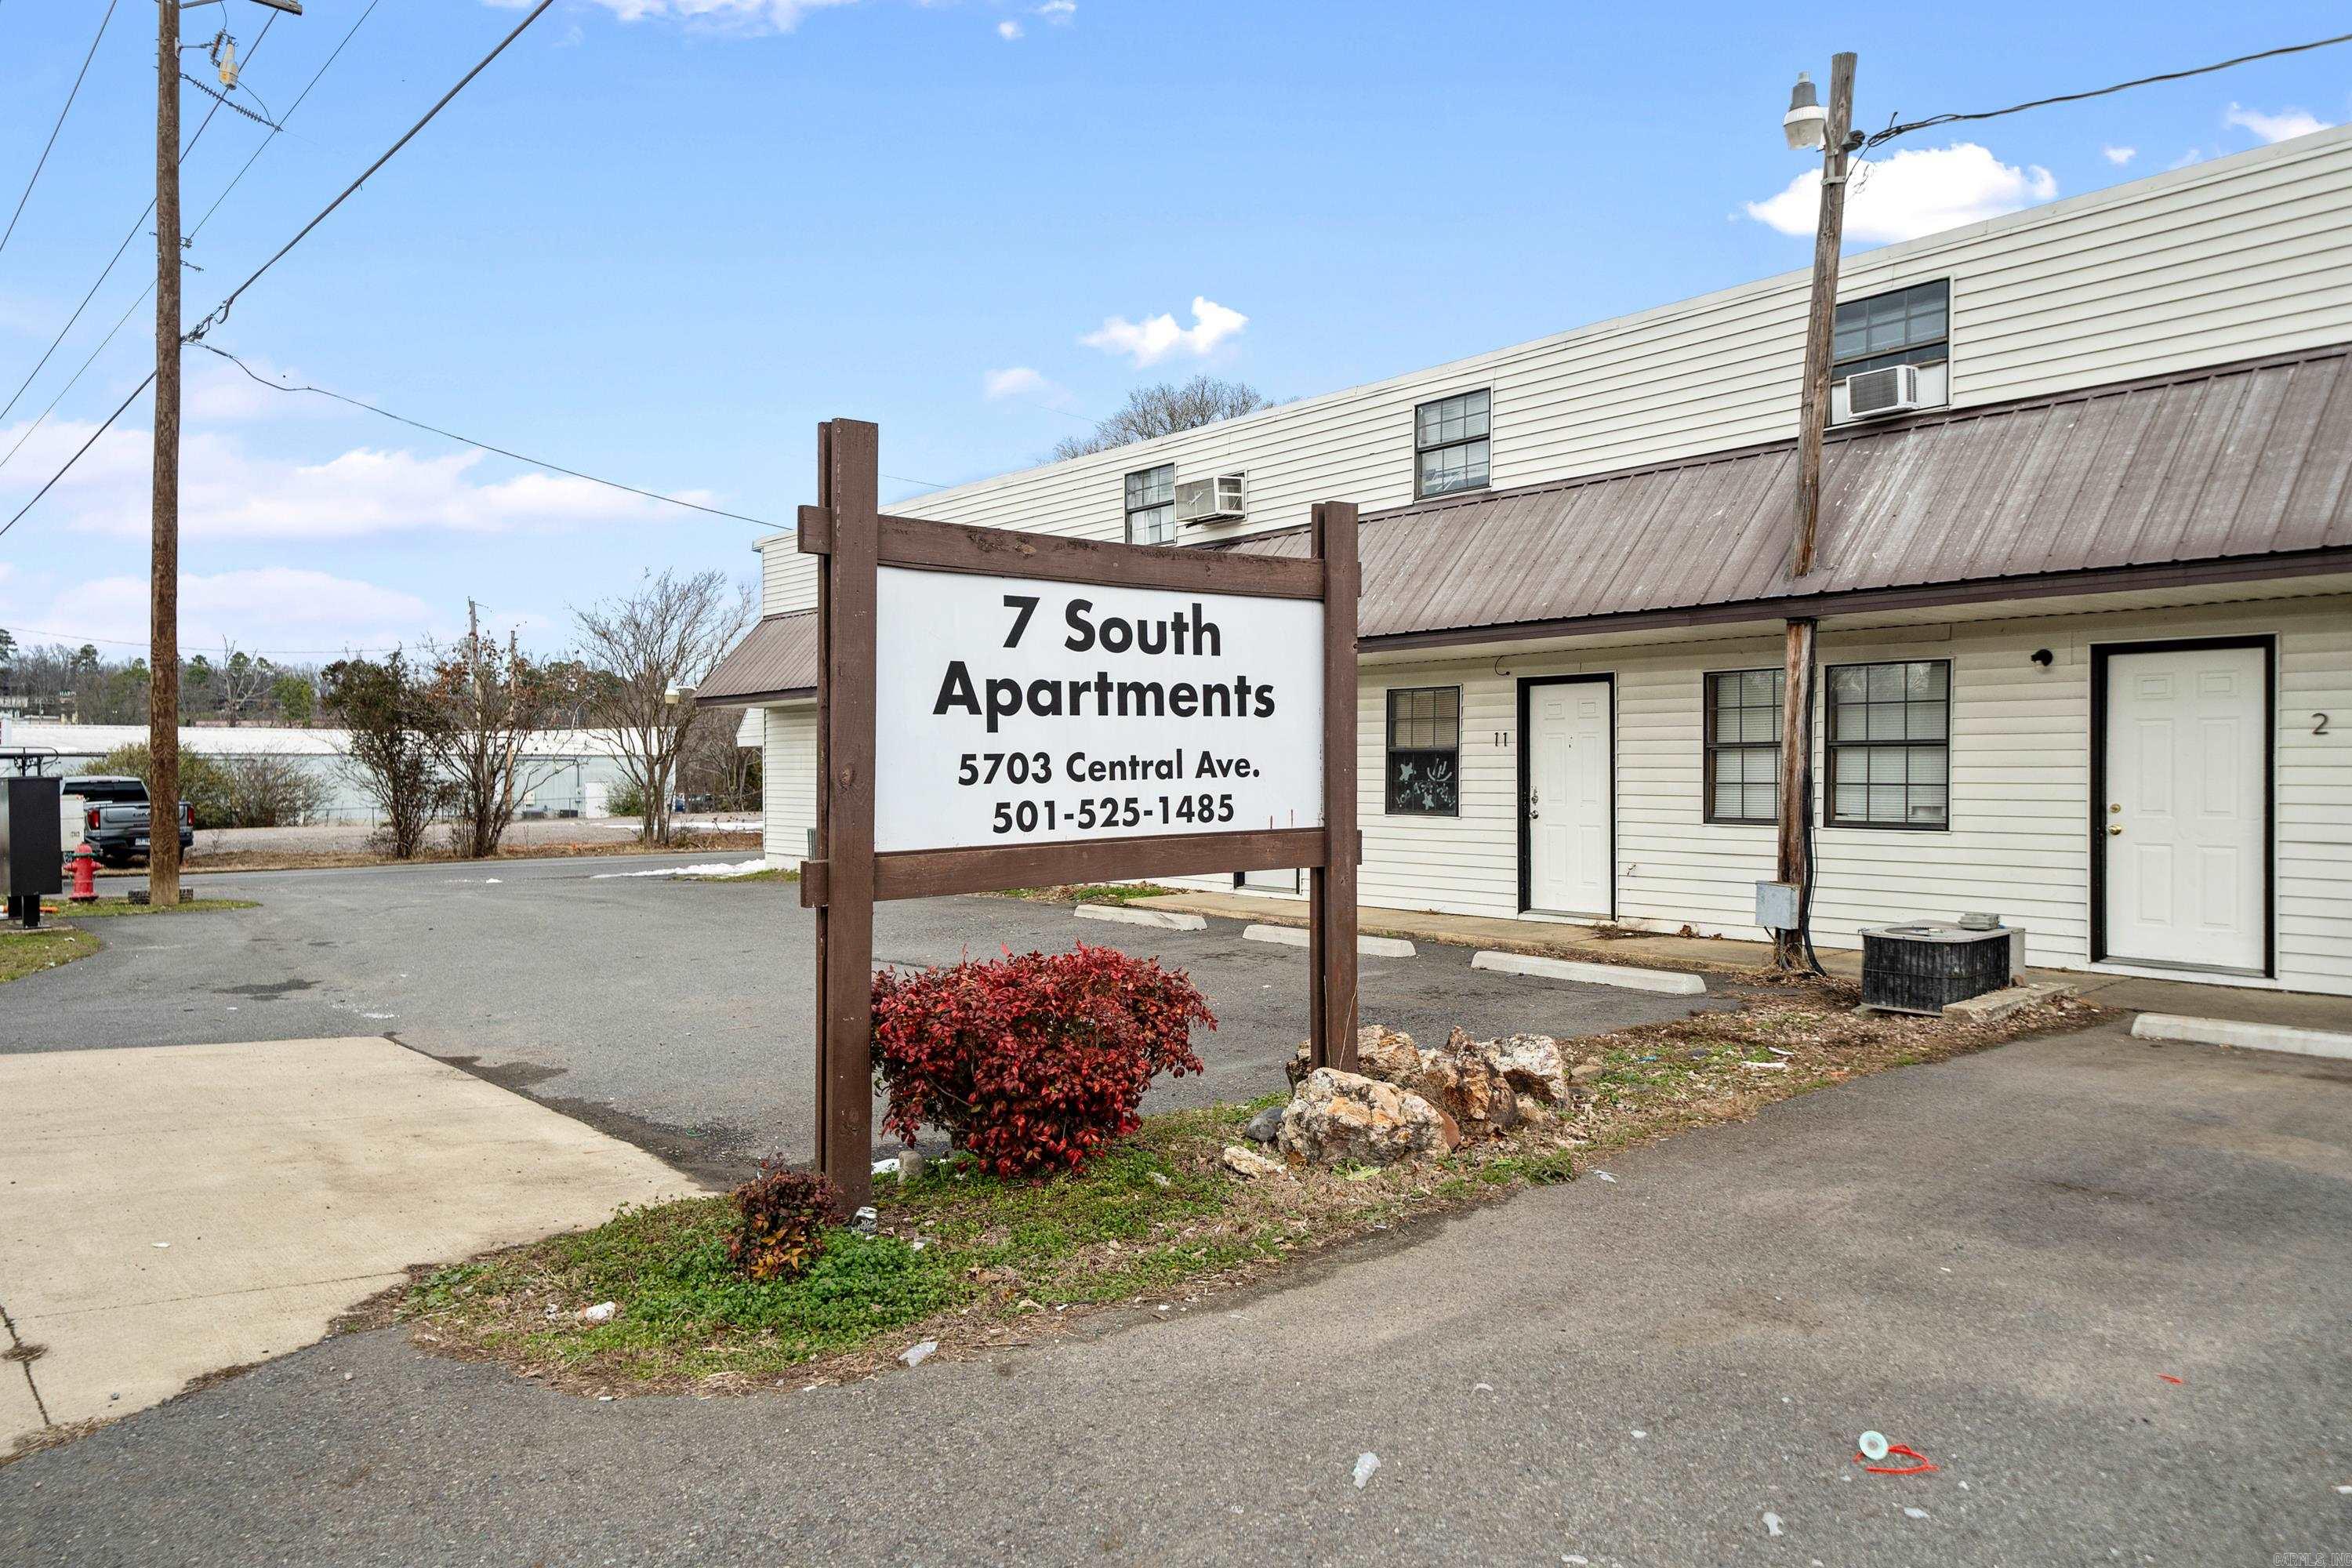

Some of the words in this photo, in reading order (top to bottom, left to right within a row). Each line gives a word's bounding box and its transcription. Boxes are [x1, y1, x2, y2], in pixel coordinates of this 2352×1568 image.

[1002, 594, 1040, 648] 7
[1064, 598, 1221, 657] South
[932, 660, 1276, 733] Apartments
[1494, 731, 1508, 747] 11
[2311, 713, 2328, 735] 2
[958, 751, 1052, 786] 5703
[1065, 748, 1183, 782] Central
[1195, 750, 1260, 779] Ave.
[993, 793, 1234, 834] 501-525-1485
